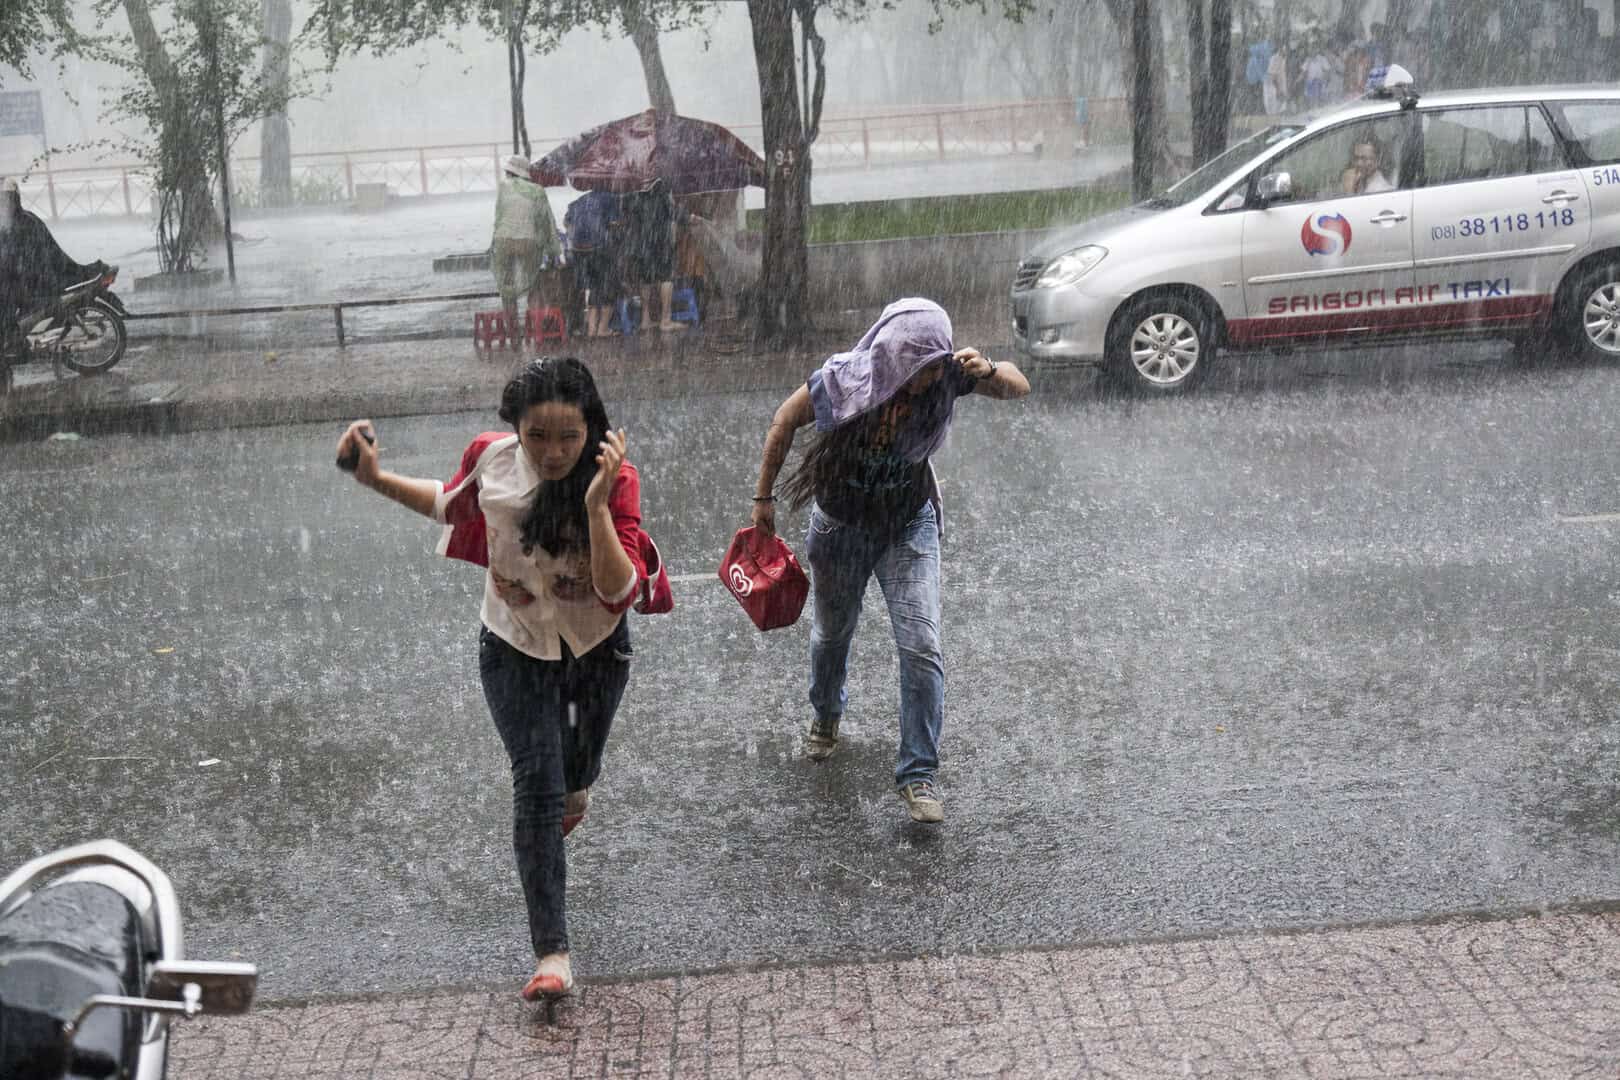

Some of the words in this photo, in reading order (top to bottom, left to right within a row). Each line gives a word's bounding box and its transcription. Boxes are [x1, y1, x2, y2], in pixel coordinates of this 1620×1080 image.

[1593, 168, 1620, 186] 51A
[1432, 226, 1456, 240] (08)
[1535, 208, 1574, 229] 118
[1447, 278, 1510, 300] TAXI
